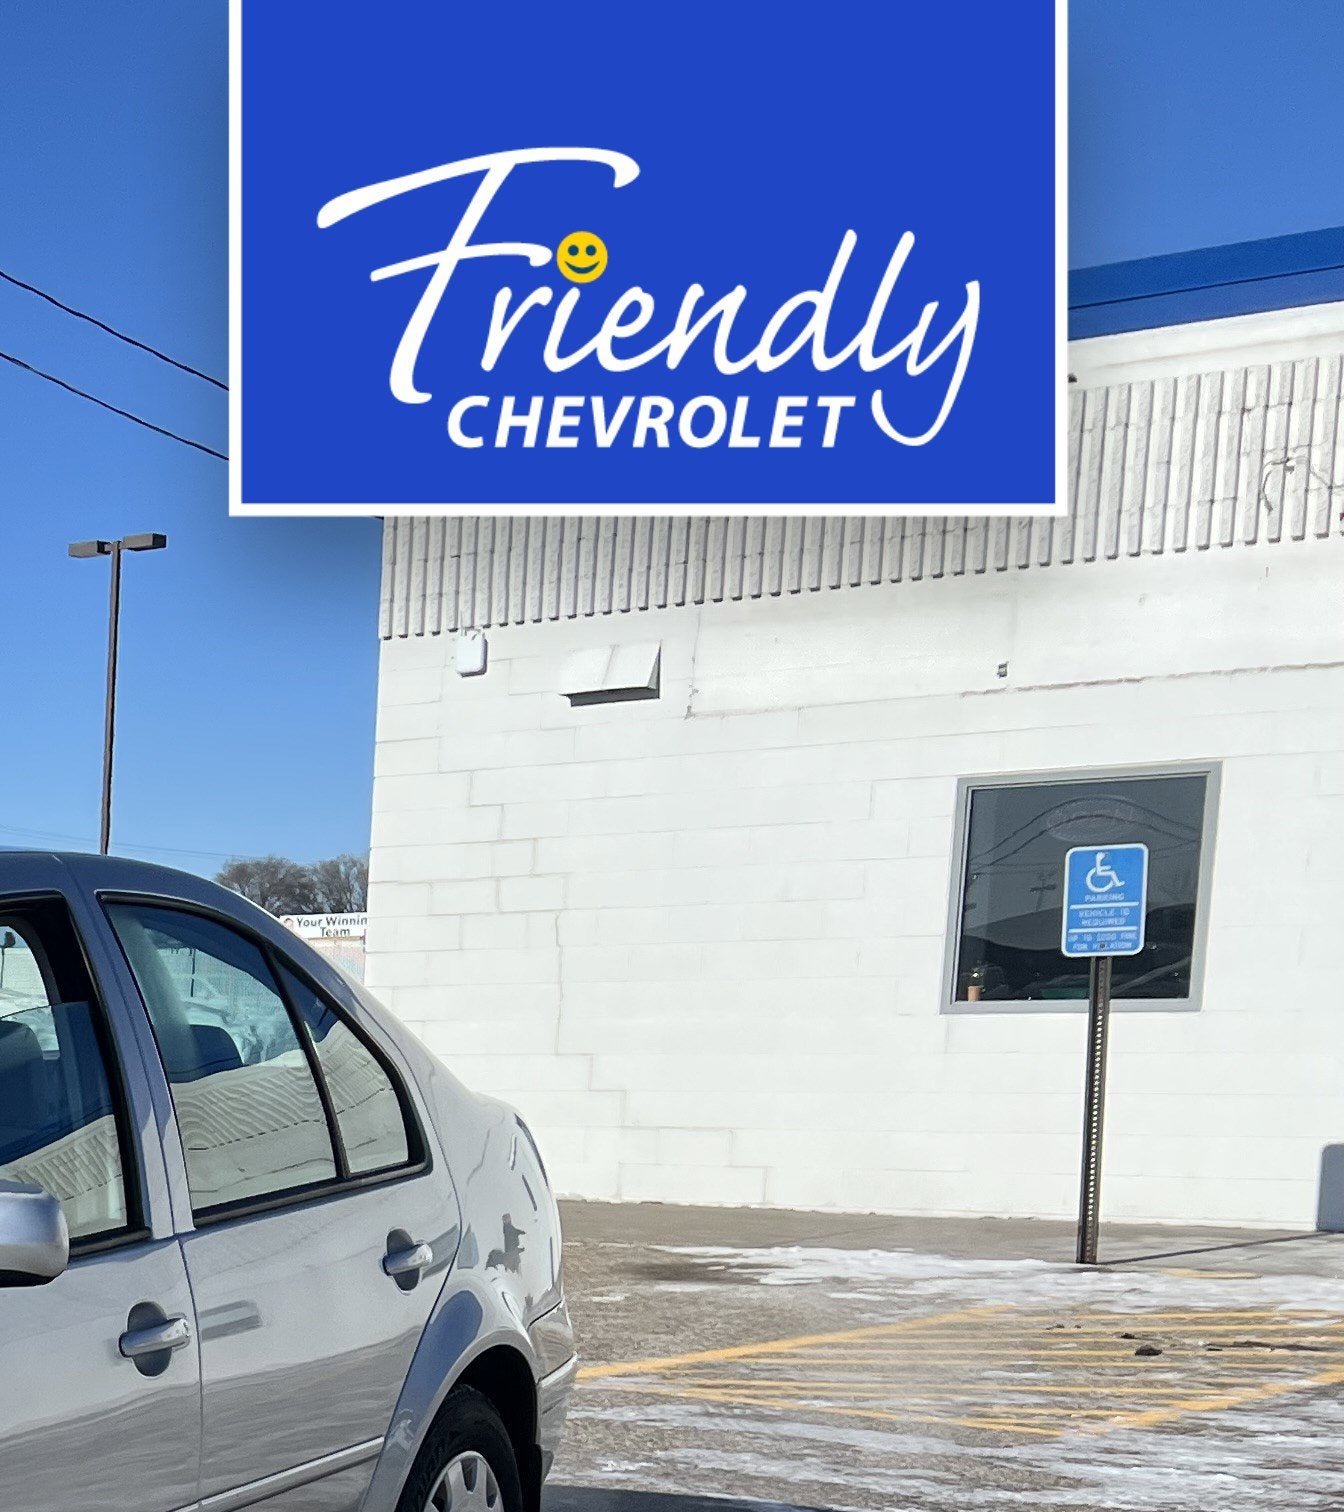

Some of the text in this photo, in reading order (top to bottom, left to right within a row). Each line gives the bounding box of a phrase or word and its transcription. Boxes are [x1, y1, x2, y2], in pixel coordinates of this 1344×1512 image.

[1084, 892, 1125, 902] PARKING
[296, 916, 323, 928] Your
[320, 926, 350, 937] Team
